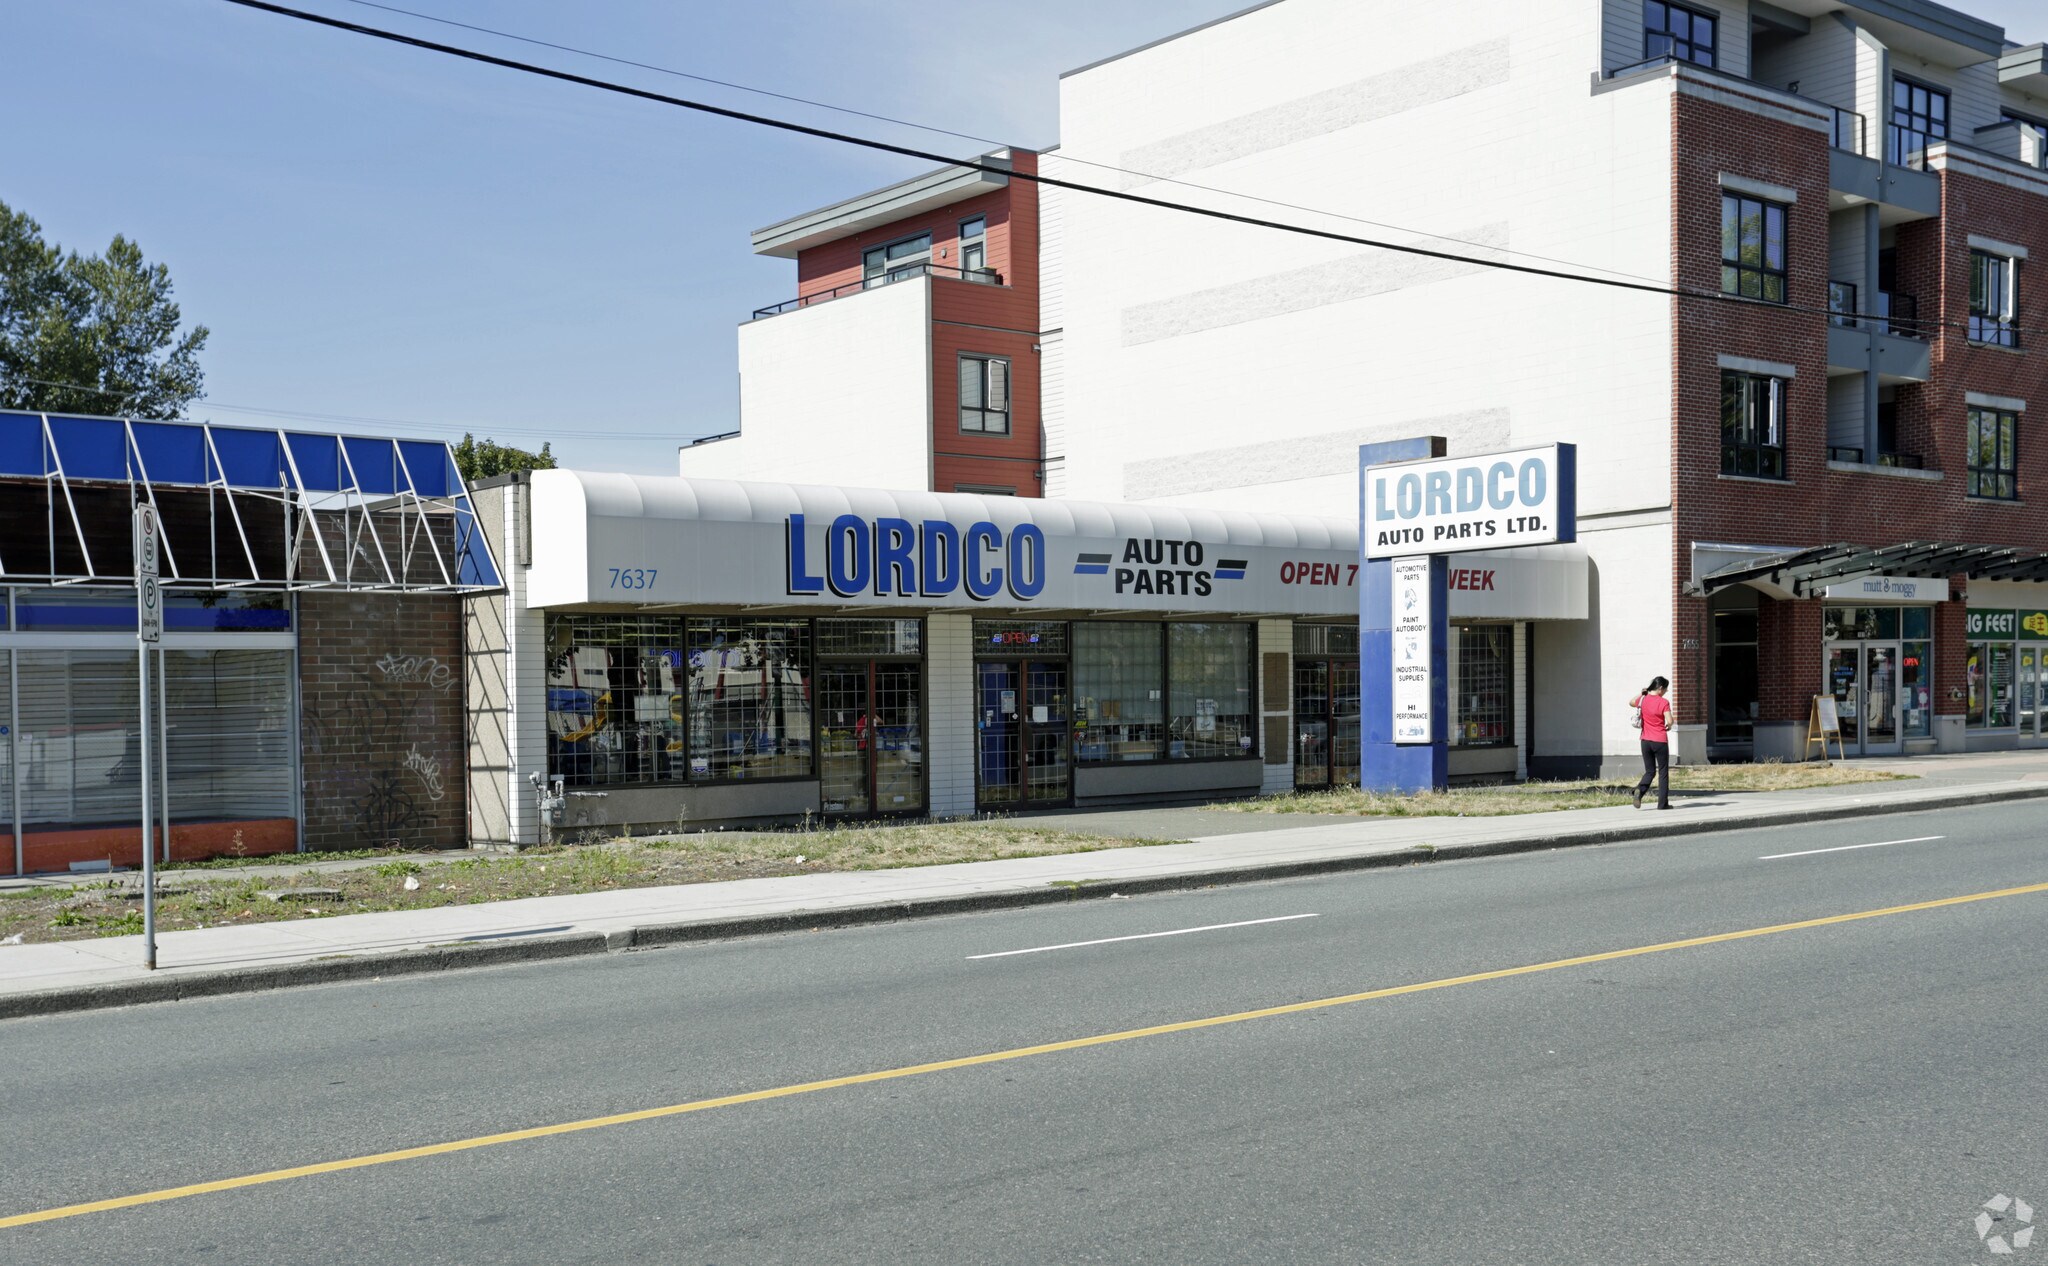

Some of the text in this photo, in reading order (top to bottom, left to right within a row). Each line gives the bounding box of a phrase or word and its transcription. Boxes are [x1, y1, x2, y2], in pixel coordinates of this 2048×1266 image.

[1375, 457, 1547, 521] LORDCO
[1378, 515, 1547, 546] AUTO PARTS LTD.
[785, 513, 1046, 602] LORDCO
[1122, 537, 1204, 567] AUTO
[1280, 561, 1340, 586] OPEN
[1347, 564, 1359, 586] 7
[1396, 564, 1427, 573] AUTOMOTIVE
[608, 567, 658, 590] 7637
[1115, 568, 1212, 597] PARTS
[1863, 580, 1882, 592] mutt
[1891, 582, 1917, 598] moggy
[1966, 614, 2014, 633] IG FEET
[1002, 632, 1031, 644] OPEN
[1396, 665, 1427, 673] INDUSTRIAL
[1903, 656, 1919, 667] OPEN
[1398, 674, 1424, 682] SUPPLIES
[1396, 712, 1428, 720] PERFORMANCE
